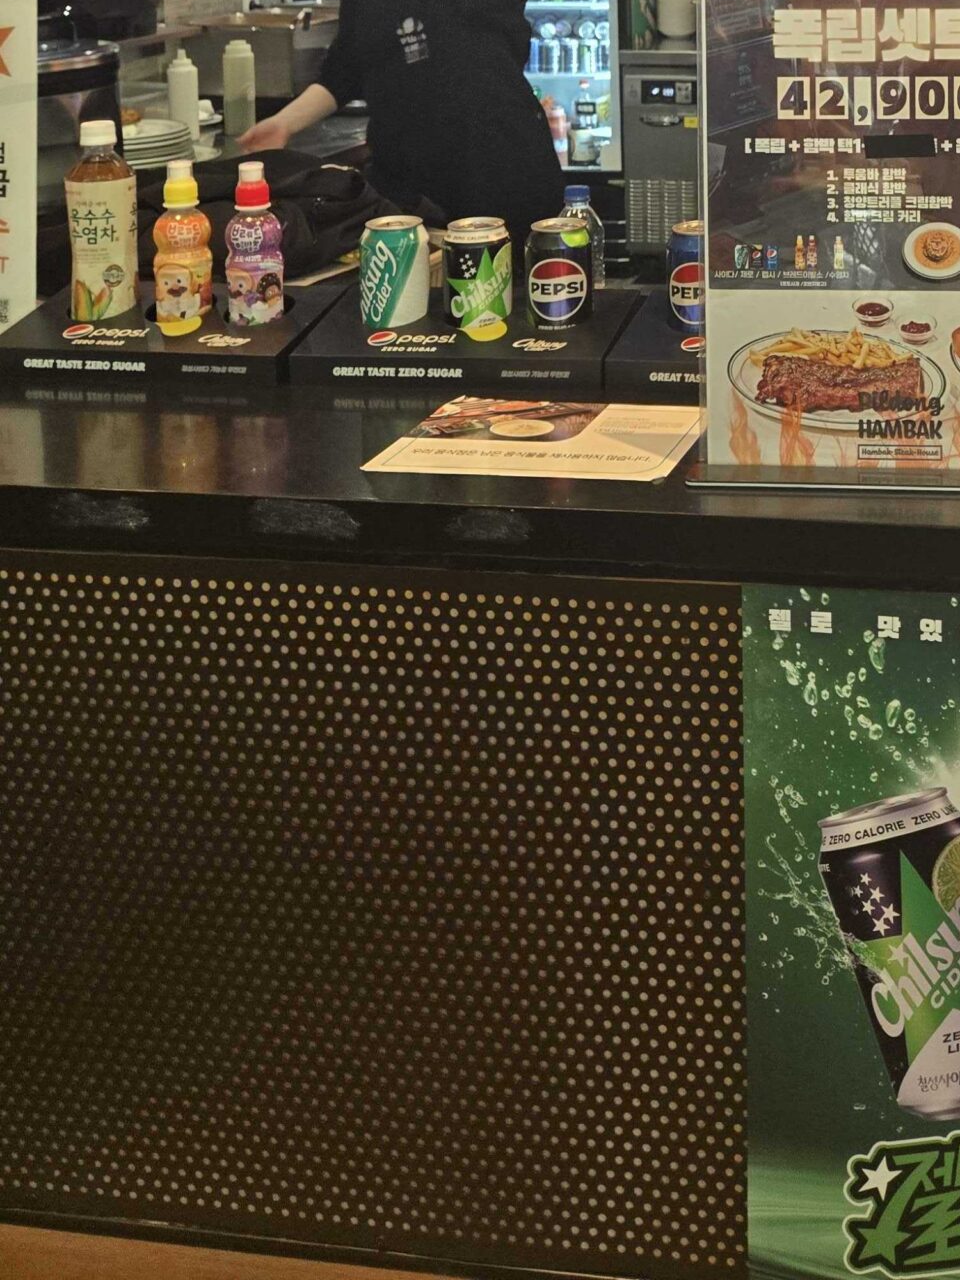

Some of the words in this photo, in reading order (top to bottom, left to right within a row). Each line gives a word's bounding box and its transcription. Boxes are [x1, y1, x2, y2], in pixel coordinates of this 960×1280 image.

[755, 138, 785, 154] 폭립
[804, 138, 835, 154] 함박
[827, 170, 839, 180] 1.
[883, 168, 907, 181] 함박
[827, 184, 839, 195] 2.
[844, 182, 879, 195] 클래식
[883, 182, 907, 195] 함박
[827, 198, 839, 209] 3.
[905, 196, 953, 209] 크림함박
[70, 208, 116, 226] 옥수수
[827, 211, 839, 223] 4.
[898, 210, 921, 223] 커리
[531, 280, 584, 296] PEPSI
[370, 273, 393, 322] Cider
[88, 327, 150, 339] pepsi
[396, 333, 457, 345] pepsi
[24, 358, 54, 369] GREAT
[55, 359, 83, 370] TASTE
[84, 360, 111, 371] ZERO
[112, 361, 146, 372] SUGAR
[333, 366, 366, 377] GREAT
[367, 367, 396, 377] TASTE
[398, 368, 426, 378] ZERO
[427, 368, 463, 378] SUGAR
[649, 372, 682, 382] GREAT
[858, 419, 943, 440] HAMBAK
[829, 833, 851, 846] ZERO
[854, 820, 906, 841] CALORIE
[911, 810, 941, 826] ZERO
